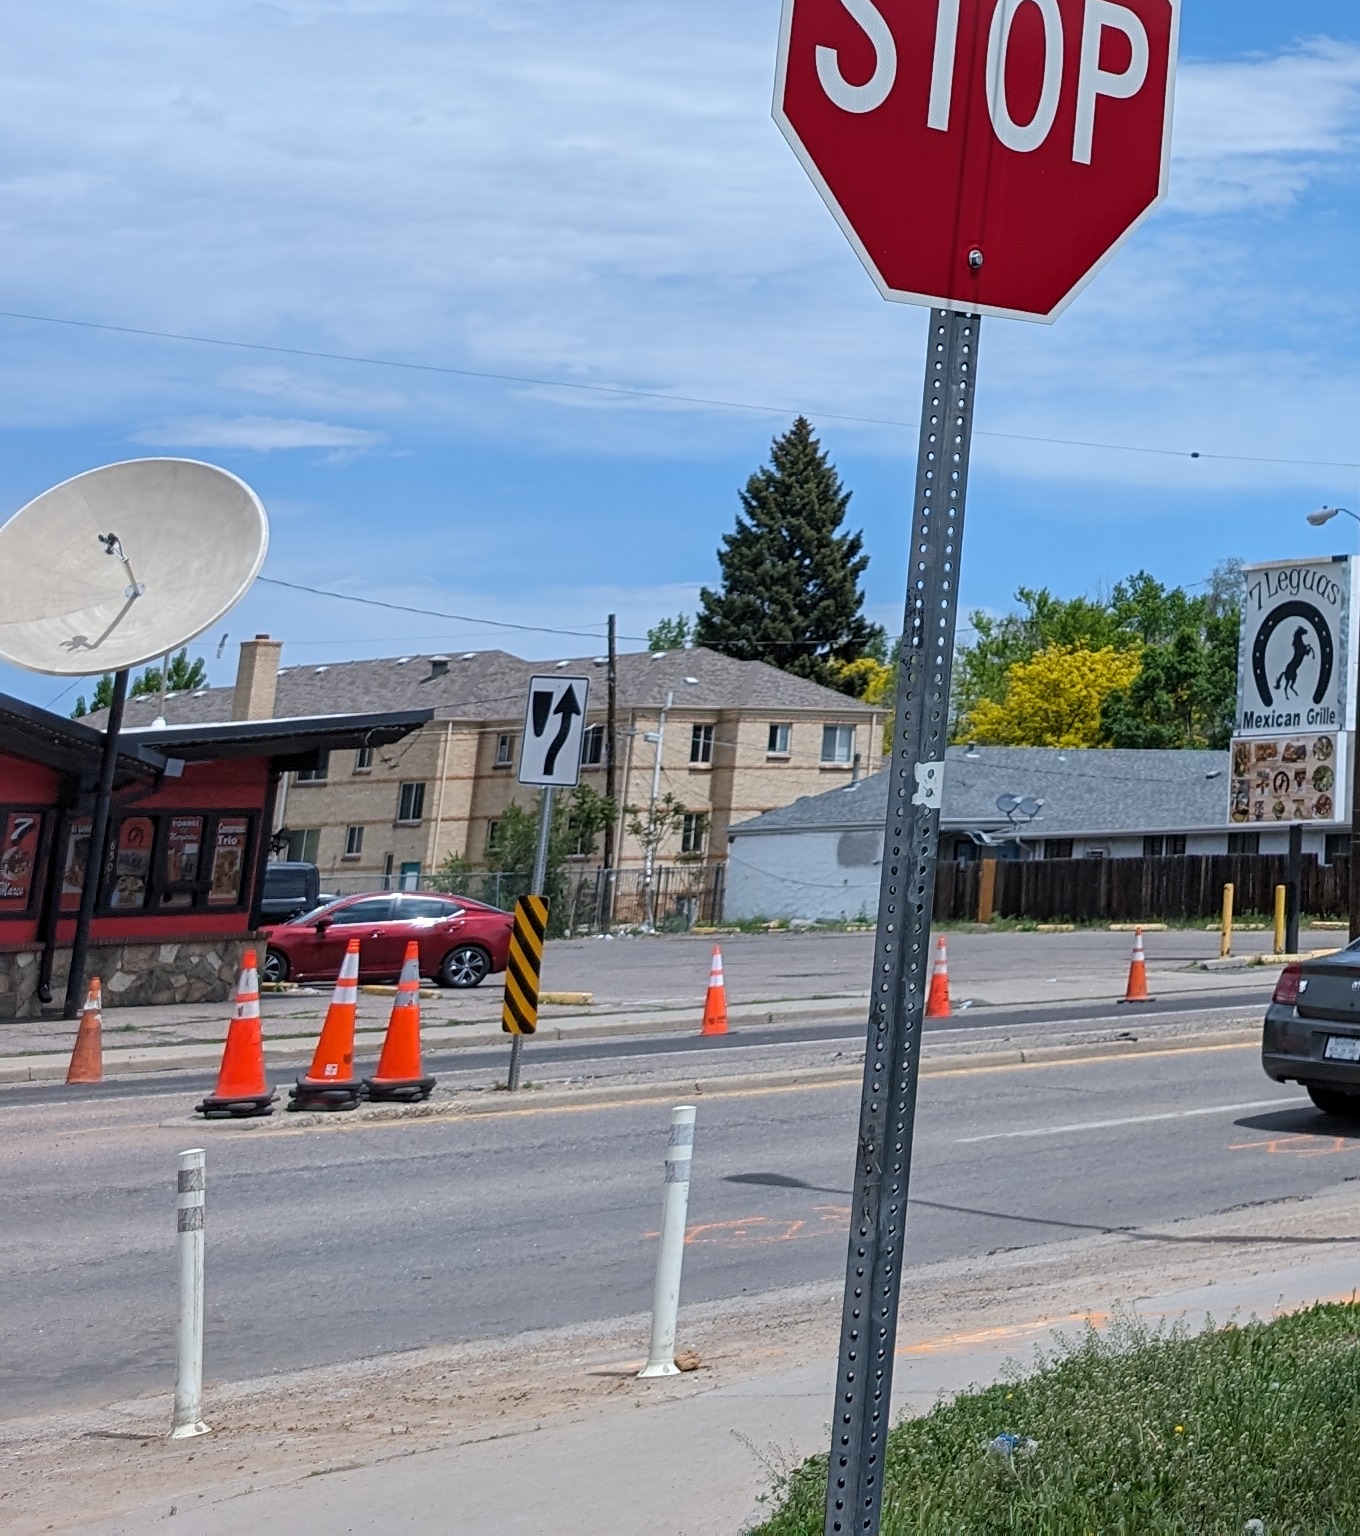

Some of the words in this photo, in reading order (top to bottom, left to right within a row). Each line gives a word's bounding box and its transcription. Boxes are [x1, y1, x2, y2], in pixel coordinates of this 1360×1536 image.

[1249, 581, 1262, 611] 7
[1264, 568, 1341, 605] Leguas
[1243, 711, 1301, 730] Mexican
[1307, 707, 1336, 726] Grille
[10, 817, 34, 840] 7
[217, 835, 238, 845] Trio
